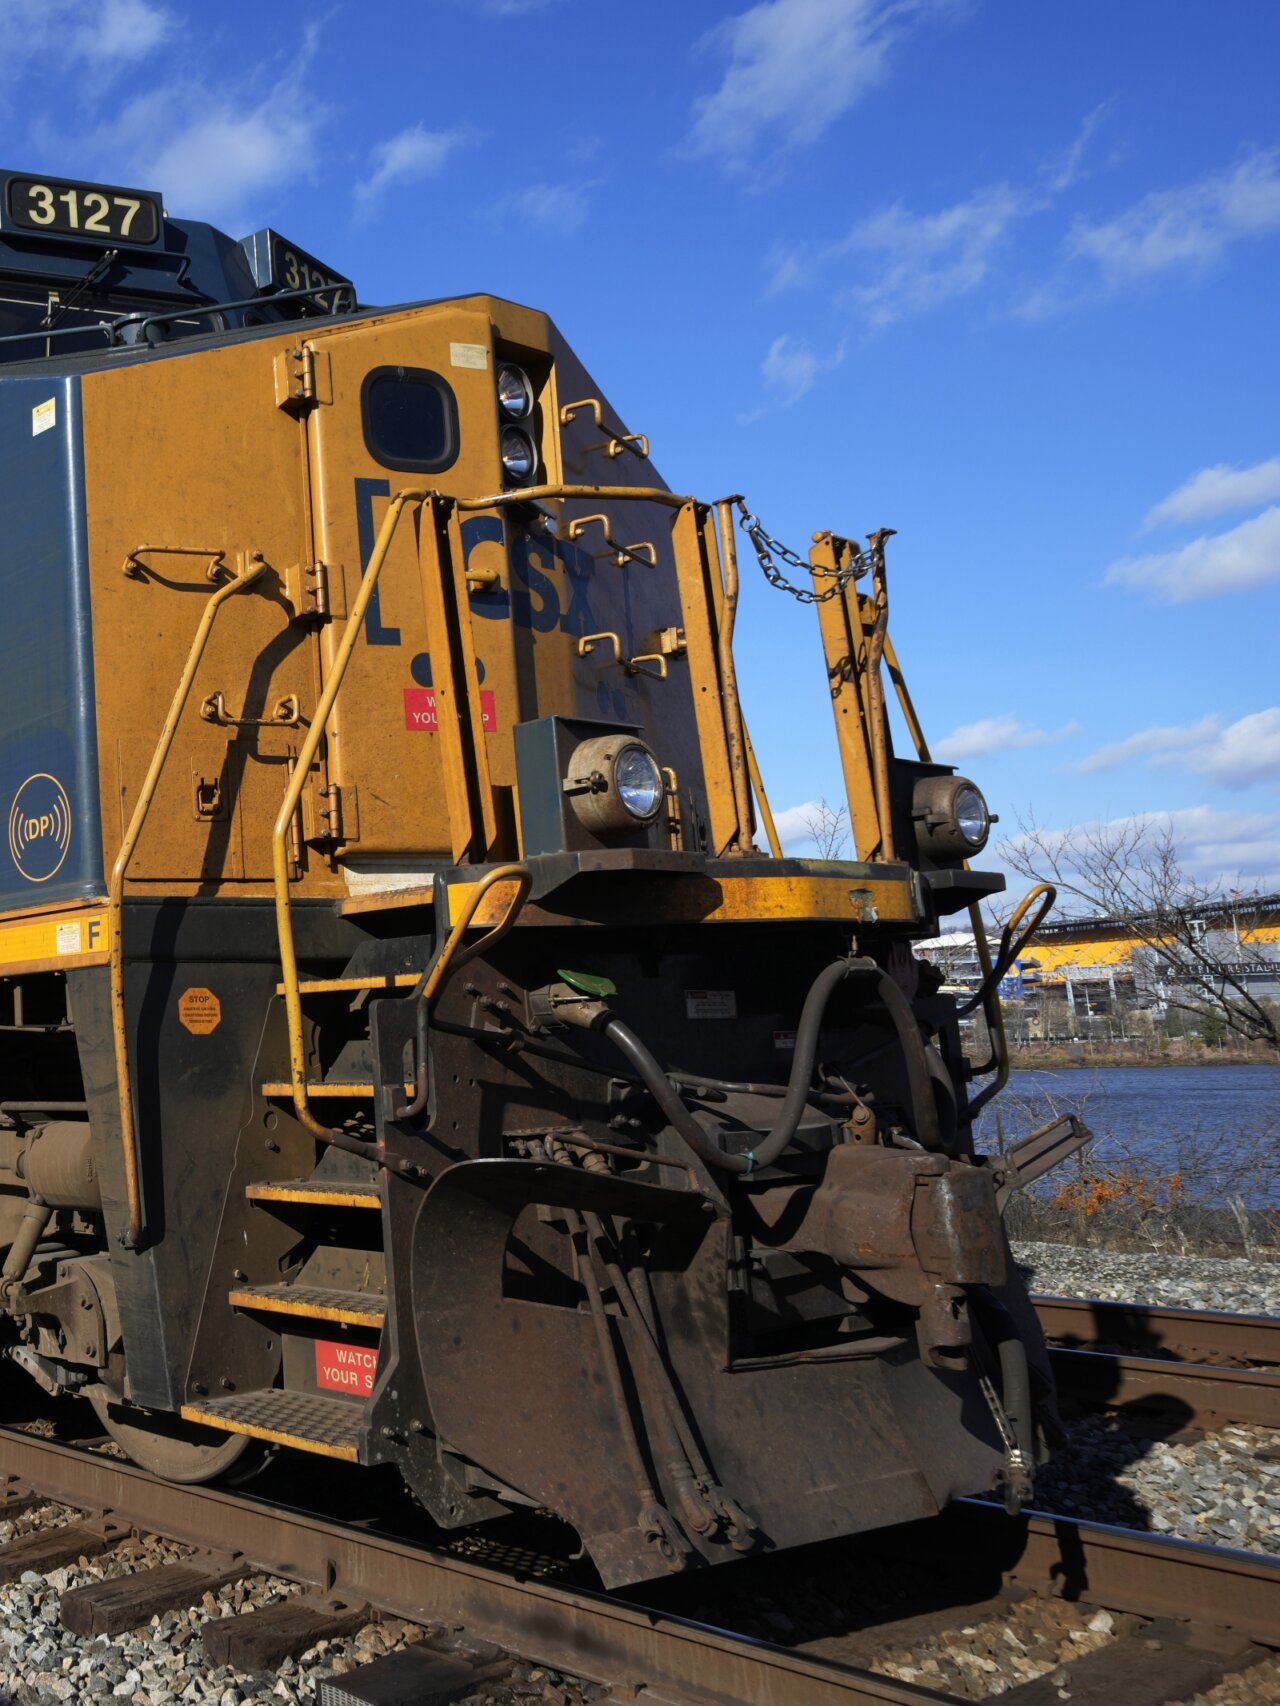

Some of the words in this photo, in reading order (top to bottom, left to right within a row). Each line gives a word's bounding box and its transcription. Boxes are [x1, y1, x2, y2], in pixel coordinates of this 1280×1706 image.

[28, 184, 141, 236] 3127
[88, 920, 101, 949] F
[188, 995, 210, 1004] STOP
[323, 1366, 359, 1386] YOUR
